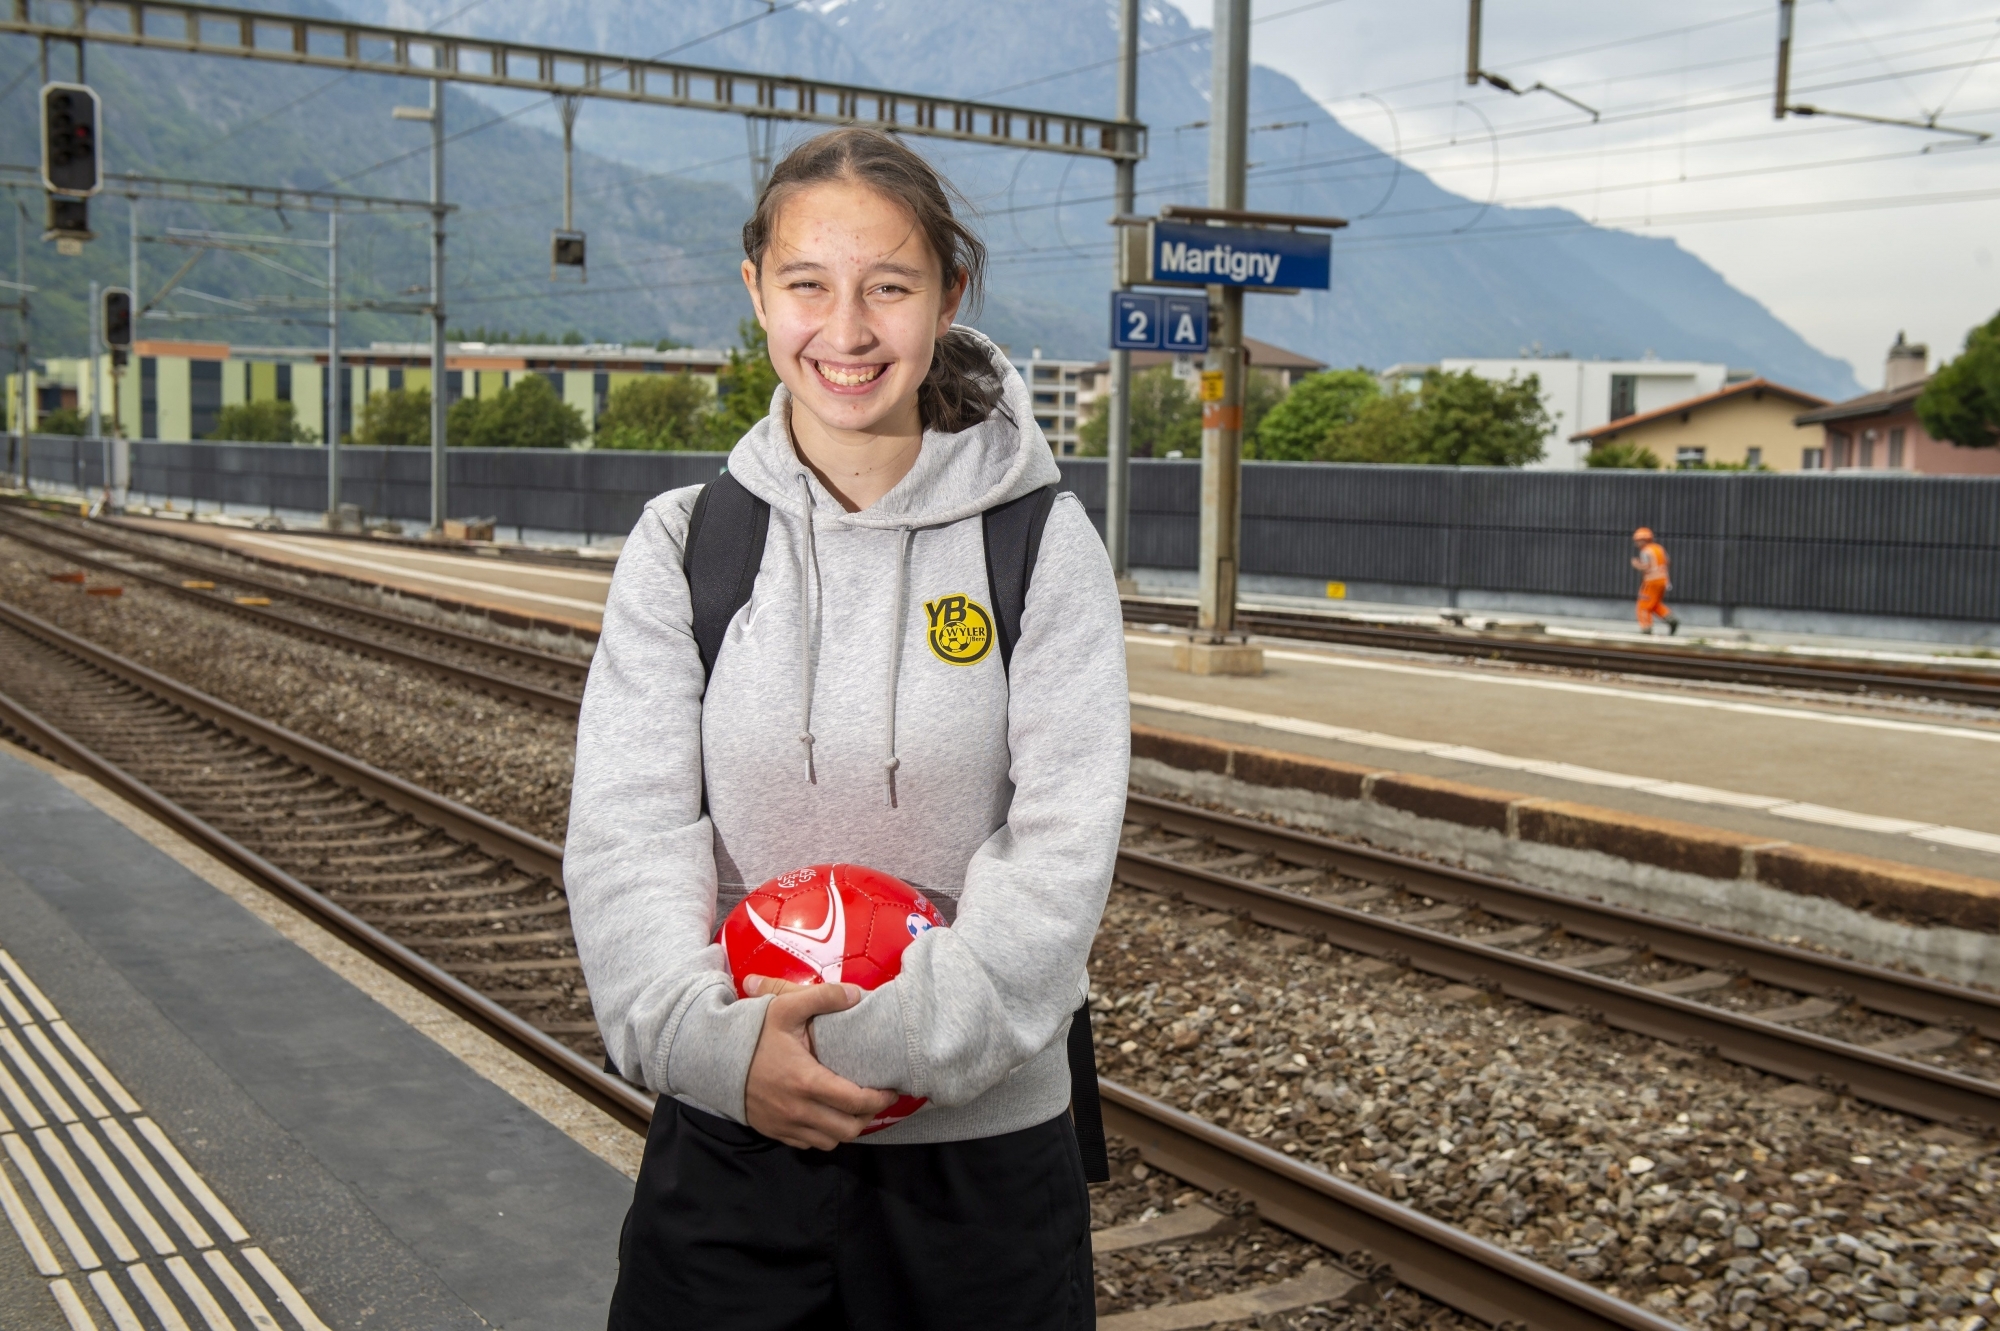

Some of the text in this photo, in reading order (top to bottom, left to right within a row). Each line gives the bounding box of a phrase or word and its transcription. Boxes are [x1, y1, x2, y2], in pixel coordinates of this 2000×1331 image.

[1161, 241, 1281, 283] Martigny
[1128, 310, 1148, 341] 2
[1174, 314, 1196, 343] A
[926, 596, 967, 628] YB
[946, 626, 986, 637] WYLER
